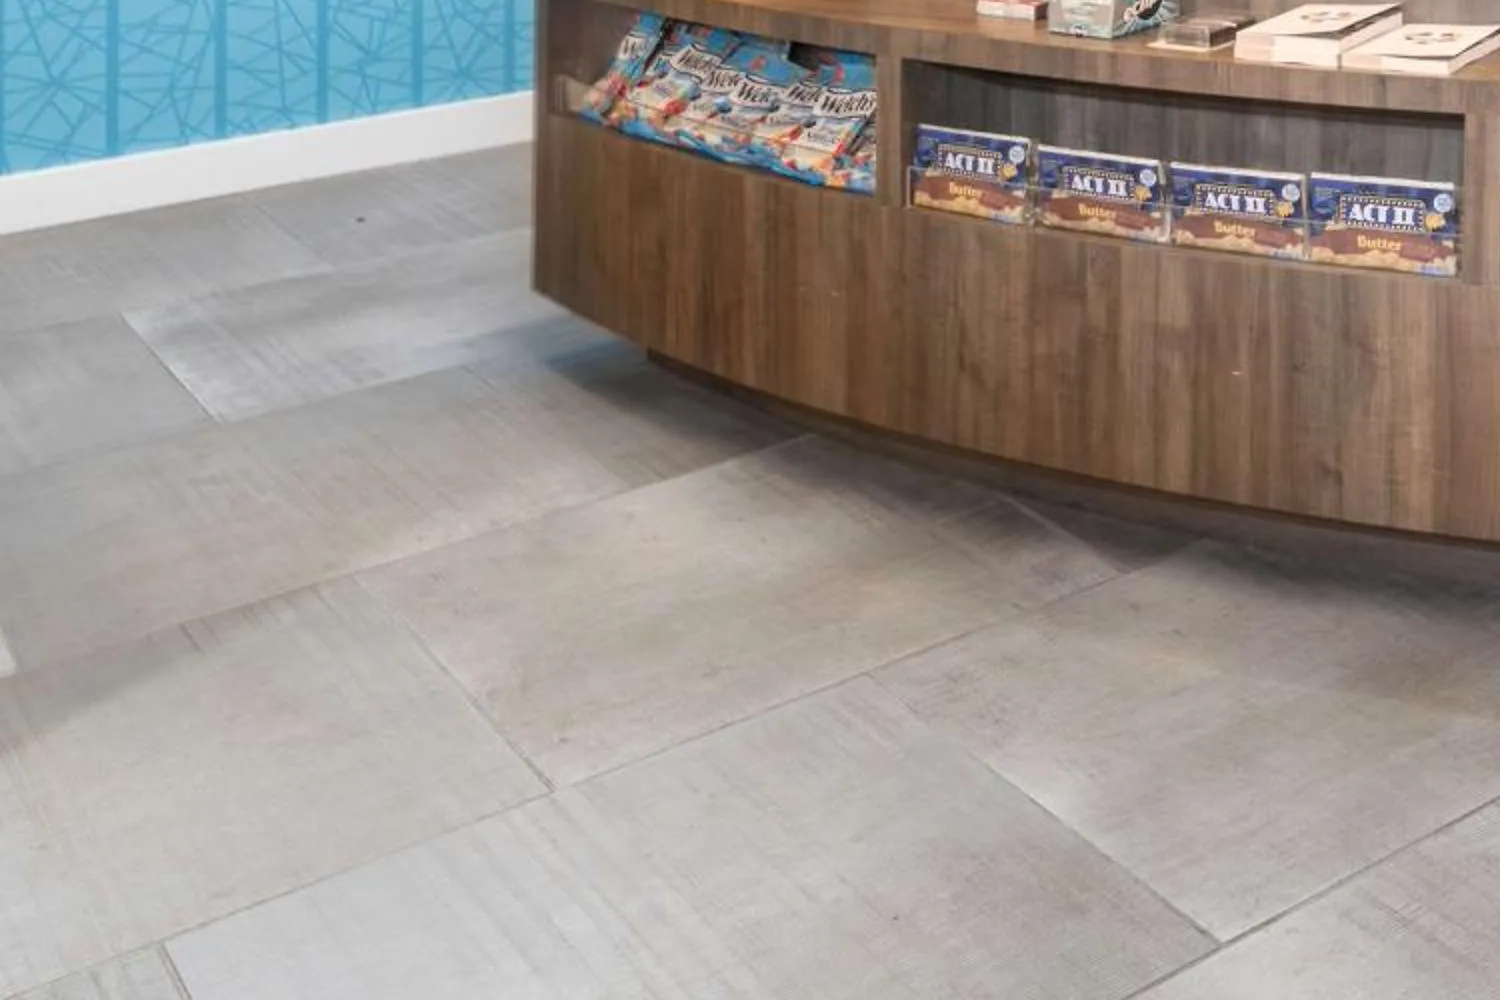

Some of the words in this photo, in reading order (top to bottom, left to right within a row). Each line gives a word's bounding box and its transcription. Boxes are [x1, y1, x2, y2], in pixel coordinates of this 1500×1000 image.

[945, 151, 974, 172] ACT
[976, 155, 996, 175] II
[1071, 174, 1104, 193] ACT
[1108, 177, 1128, 197] II
[1204, 192, 1241, 211] ACT
[1244, 194, 1266, 214] II
[1350, 203, 1388, 223] ACT
[1390, 206, 1415, 226] II
[1213, 220, 1257, 238] Butter
[1356, 234, 1403, 252] Butter
